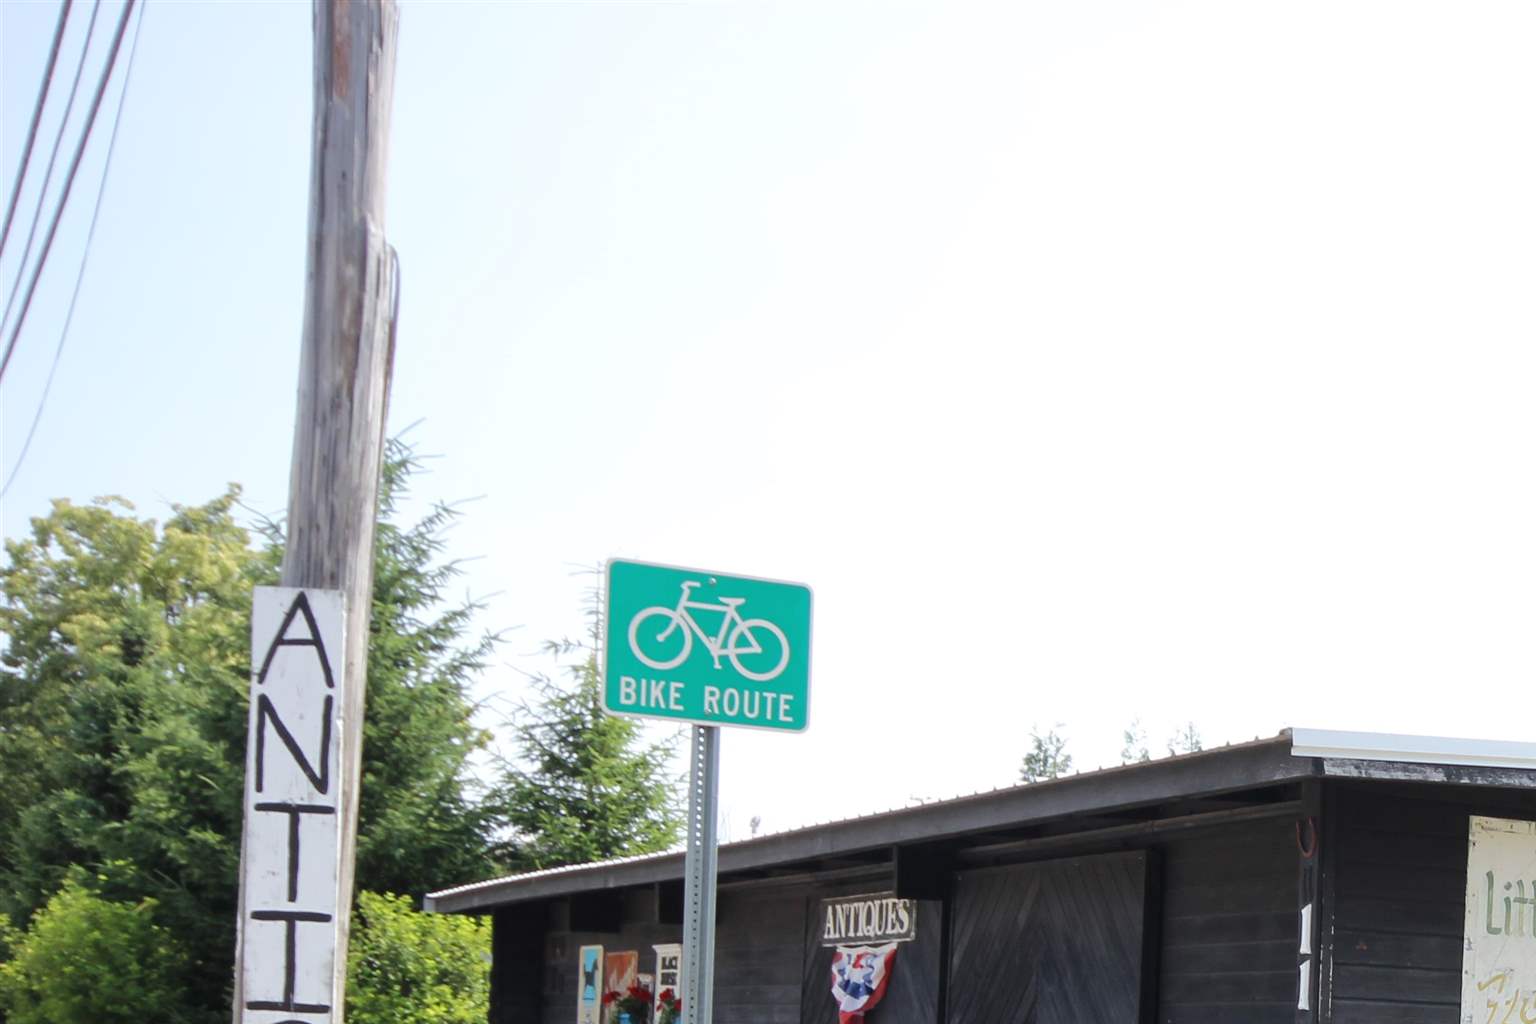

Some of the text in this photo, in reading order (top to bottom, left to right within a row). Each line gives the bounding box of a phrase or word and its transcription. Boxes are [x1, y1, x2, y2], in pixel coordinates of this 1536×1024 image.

[619, 675, 795, 723] BIKE ROUTE
[823, 898, 910, 939] ANTIQUES
